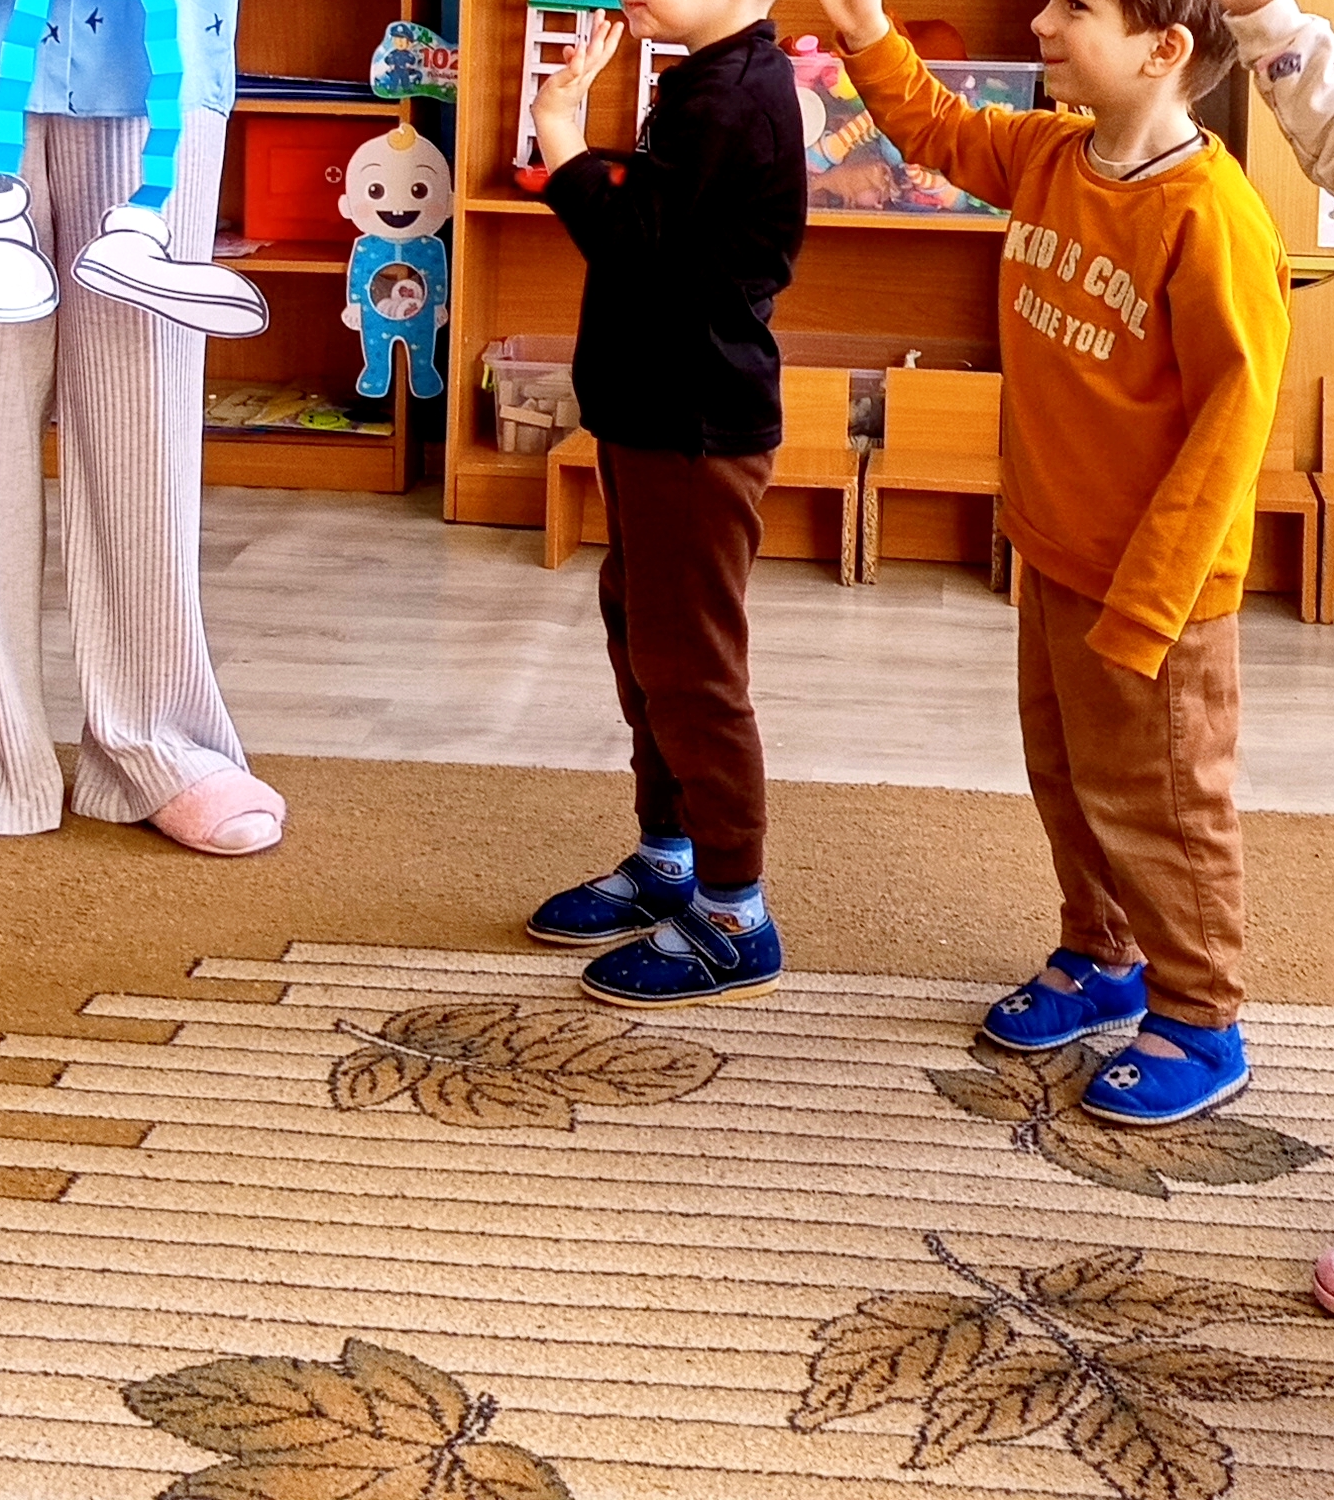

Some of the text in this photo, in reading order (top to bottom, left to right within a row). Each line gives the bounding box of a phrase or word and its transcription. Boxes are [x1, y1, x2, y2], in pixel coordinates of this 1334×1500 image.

[1004, 220, 1058, 269] KID
[1057, 238, 1082, 282] IS
[1063, 314, 1116, 360] YOU
